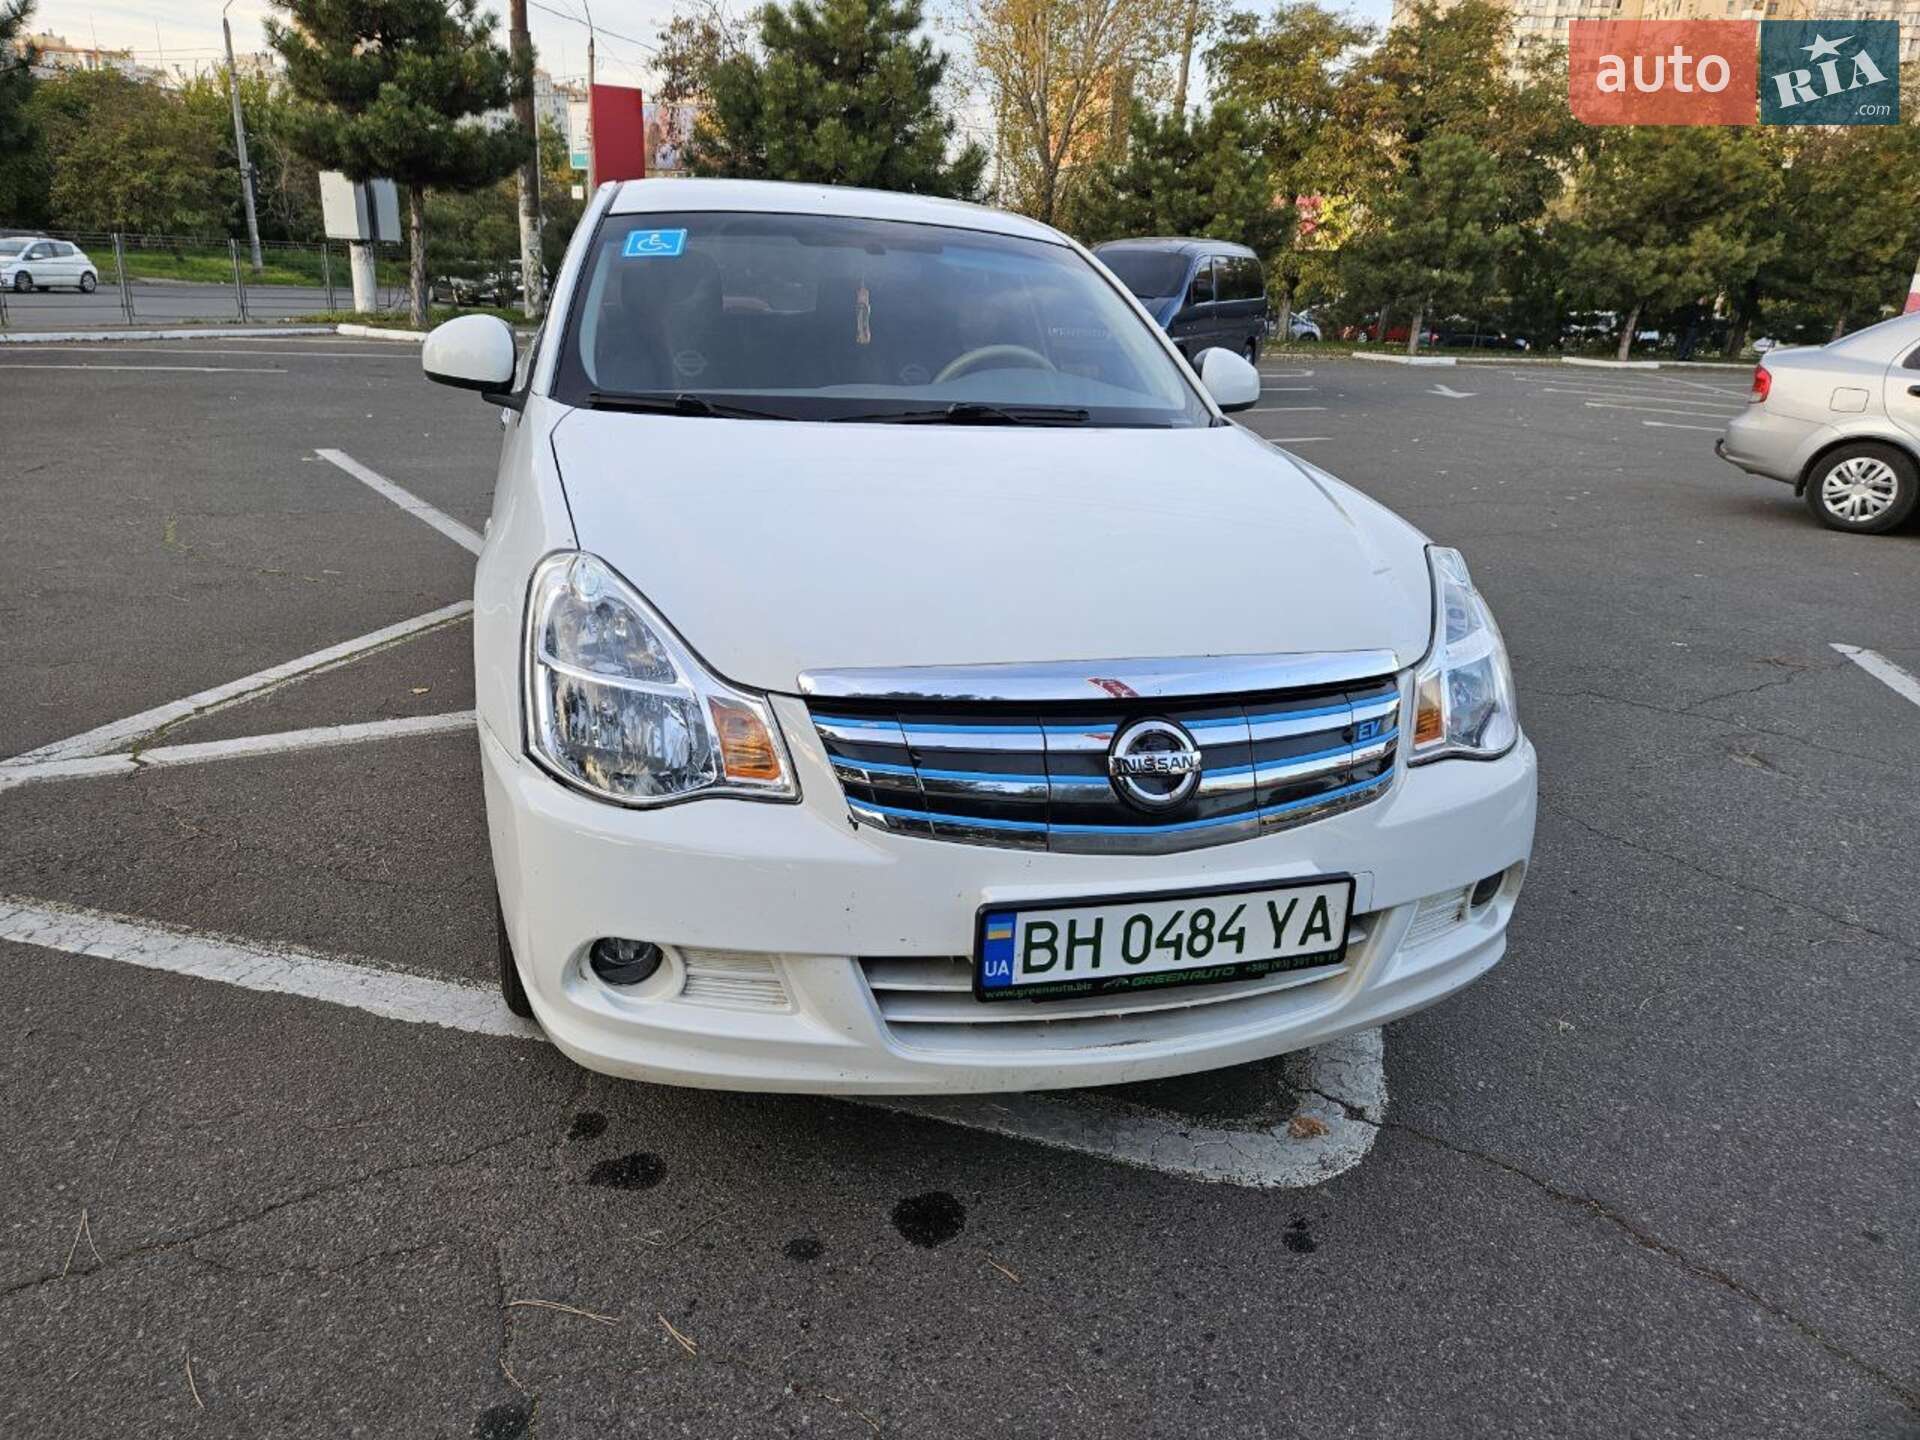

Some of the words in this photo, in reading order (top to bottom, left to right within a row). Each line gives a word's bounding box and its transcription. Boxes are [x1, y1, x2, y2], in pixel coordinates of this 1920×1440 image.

[1121, 755, 1194, 774] NISSAN
[1022, 917, 1104, 974] BH
[1121, 903, 1247, 964] 0484
[1267, 895, 1333, 949] YA
[985, 961, 1010, 977] UA
[1131, 966, 1235, 987] GREENAUTO
